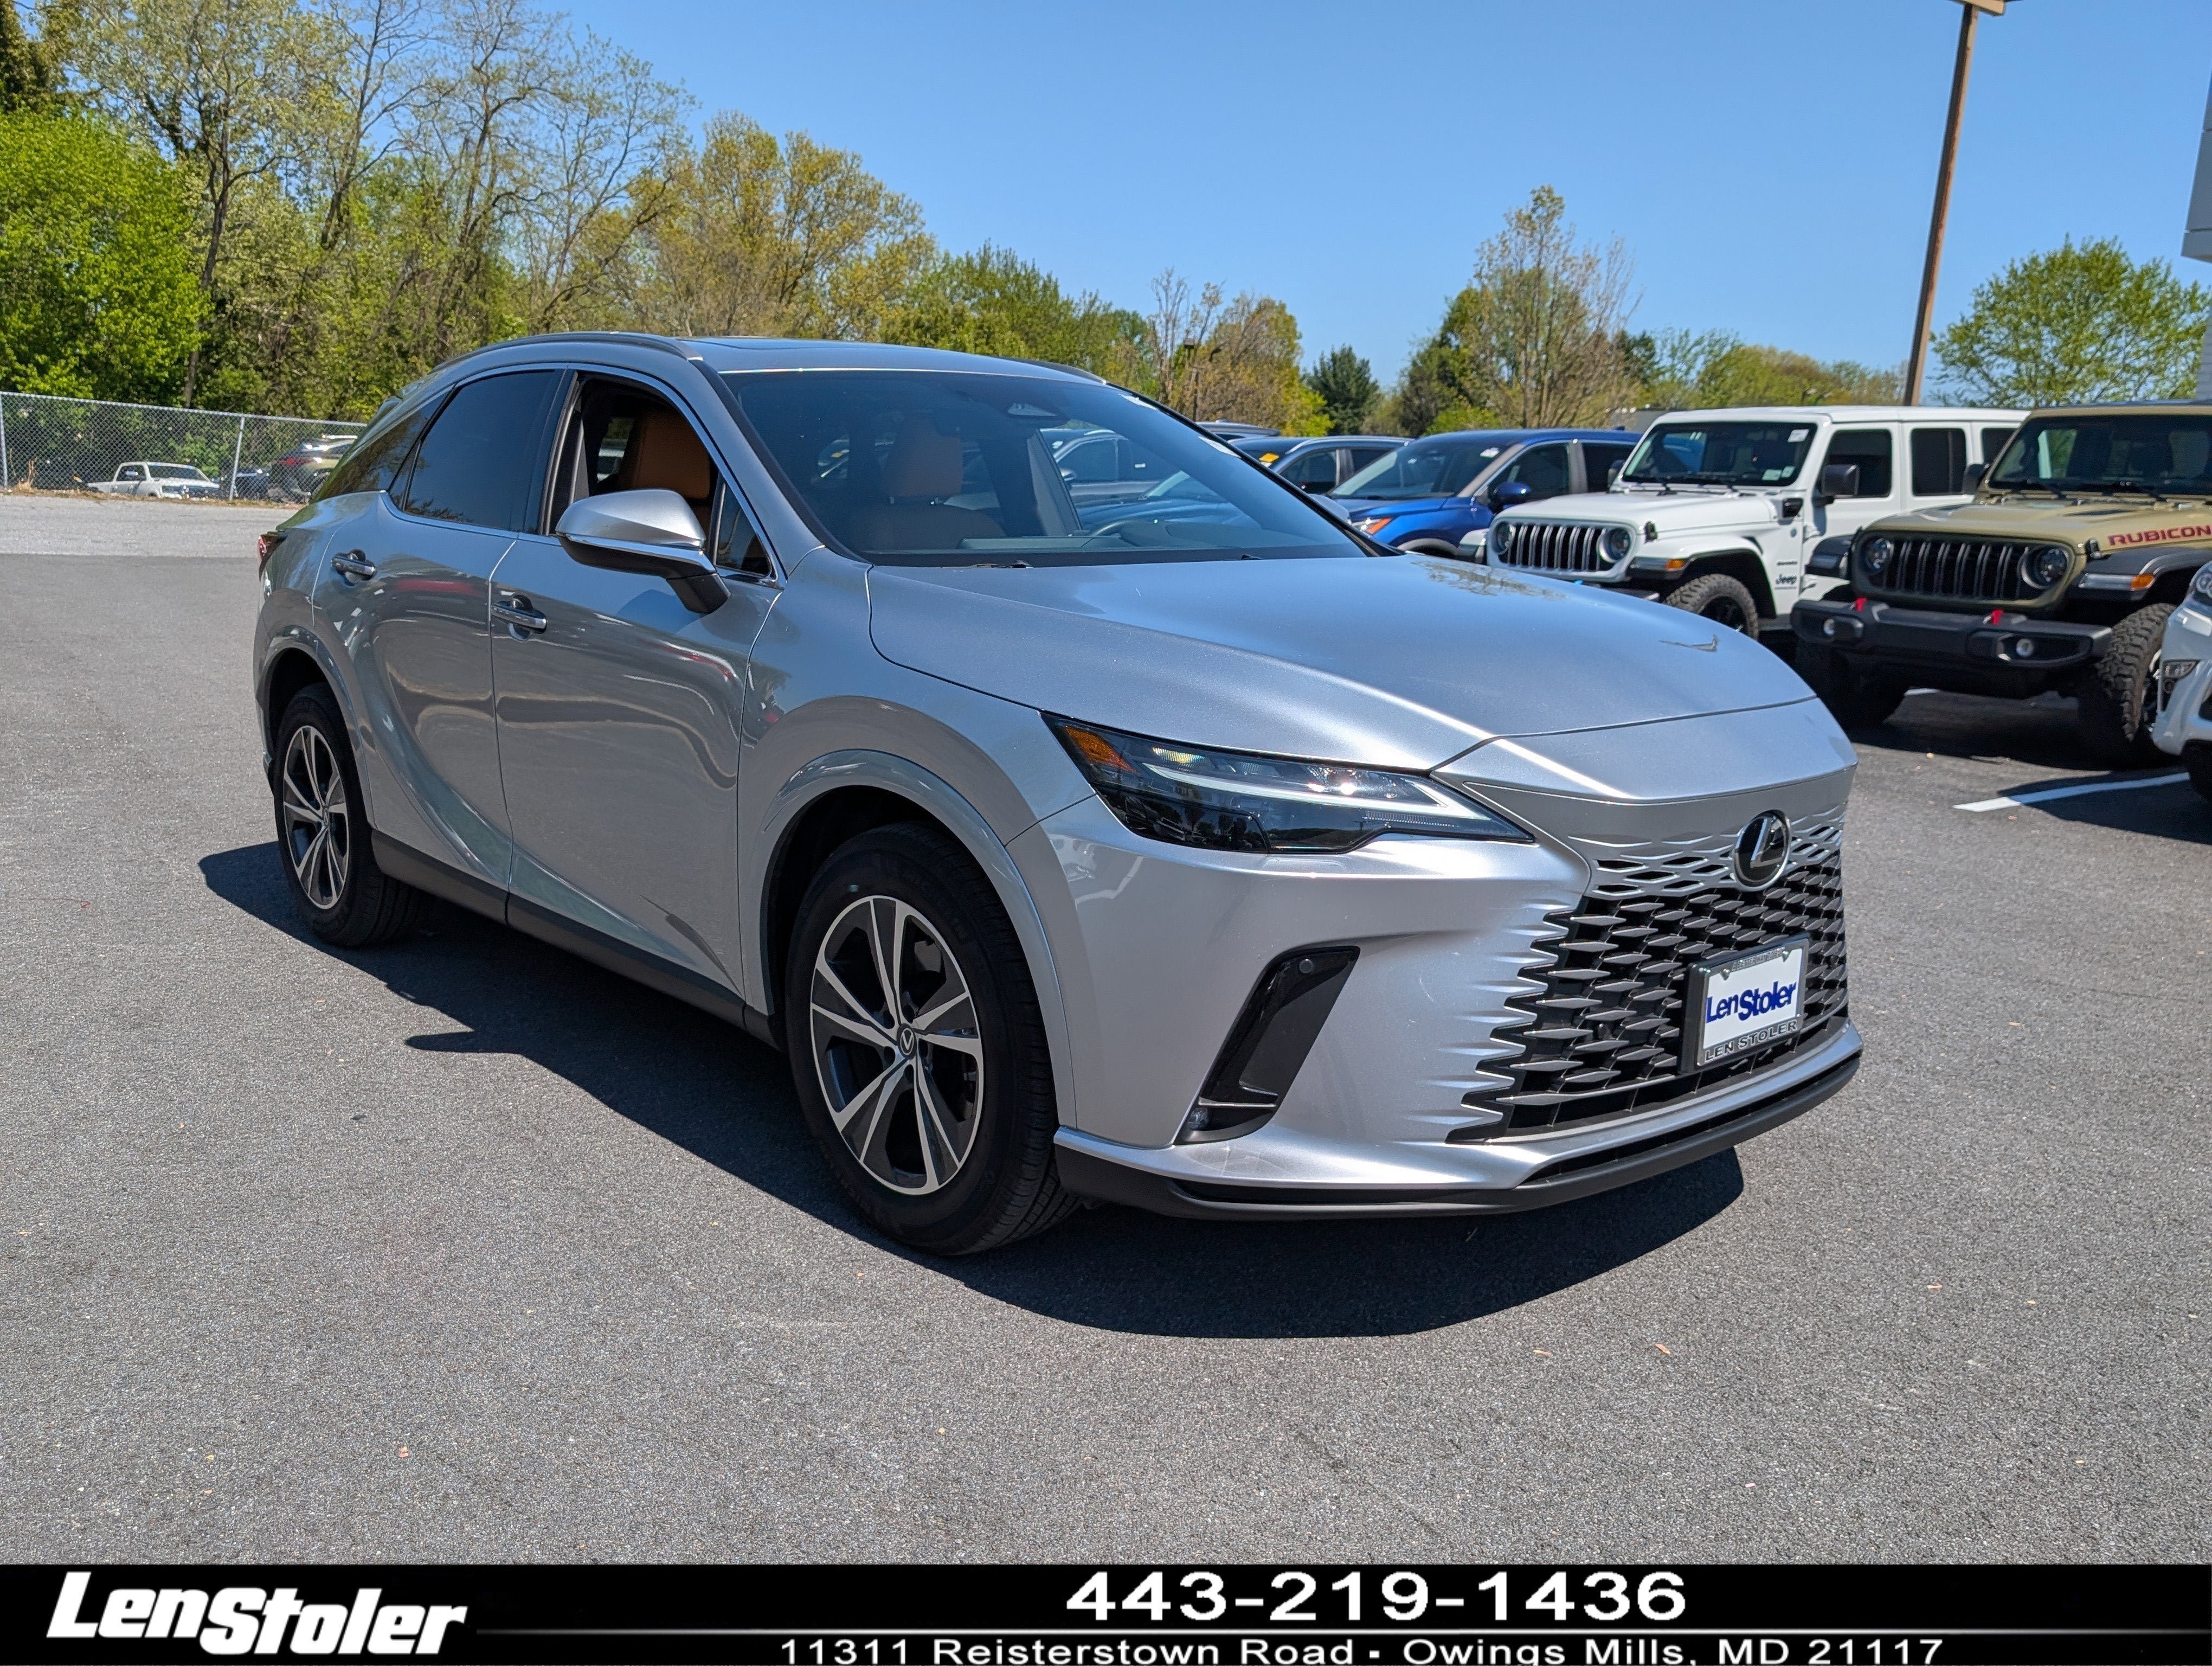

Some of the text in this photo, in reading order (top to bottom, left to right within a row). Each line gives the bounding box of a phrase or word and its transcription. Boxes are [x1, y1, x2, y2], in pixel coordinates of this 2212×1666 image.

[2108, 524, 2212, 546] RUBICON
[1776, 573, 1797, 585] Jeep
[1706, 981, 1797, 1023] LenStoler
[1705, 1019, 1798, 1062] LEN STOLER
